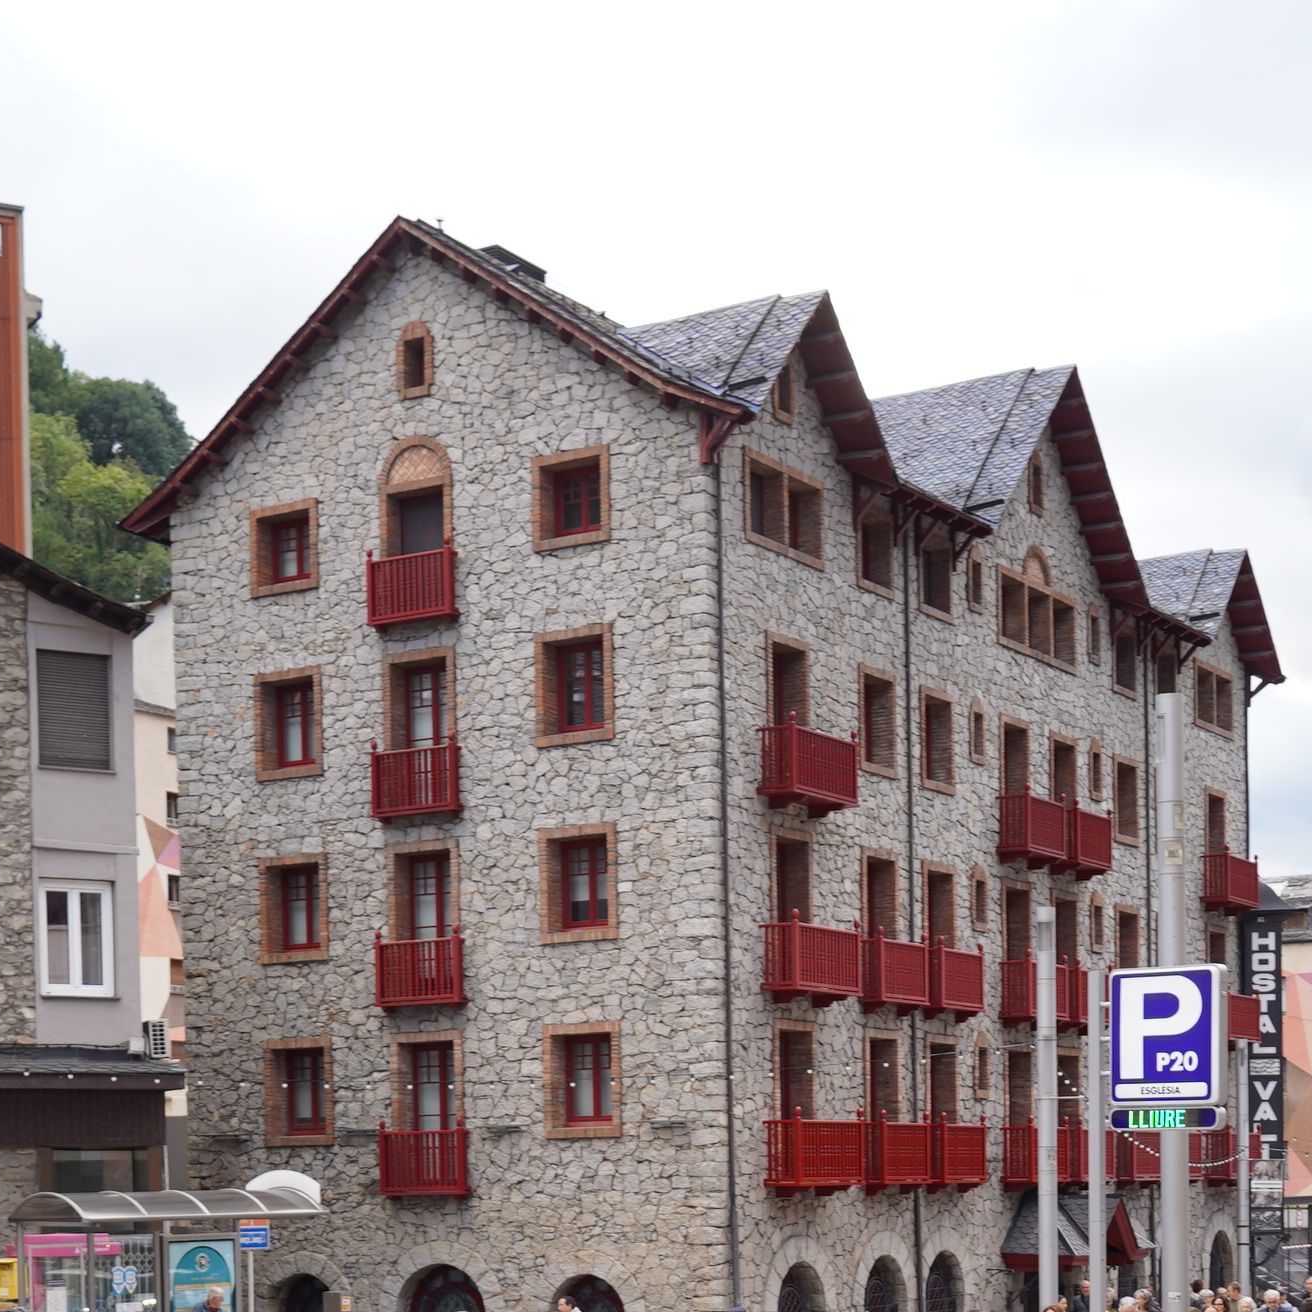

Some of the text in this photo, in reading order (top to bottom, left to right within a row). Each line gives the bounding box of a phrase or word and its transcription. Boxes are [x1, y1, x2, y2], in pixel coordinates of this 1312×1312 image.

[1119, 974, 1203, 1080] P
[1156, 1050, 1199, 1073] P20
[1128, 1109, 1187, 1129] LLIURE
